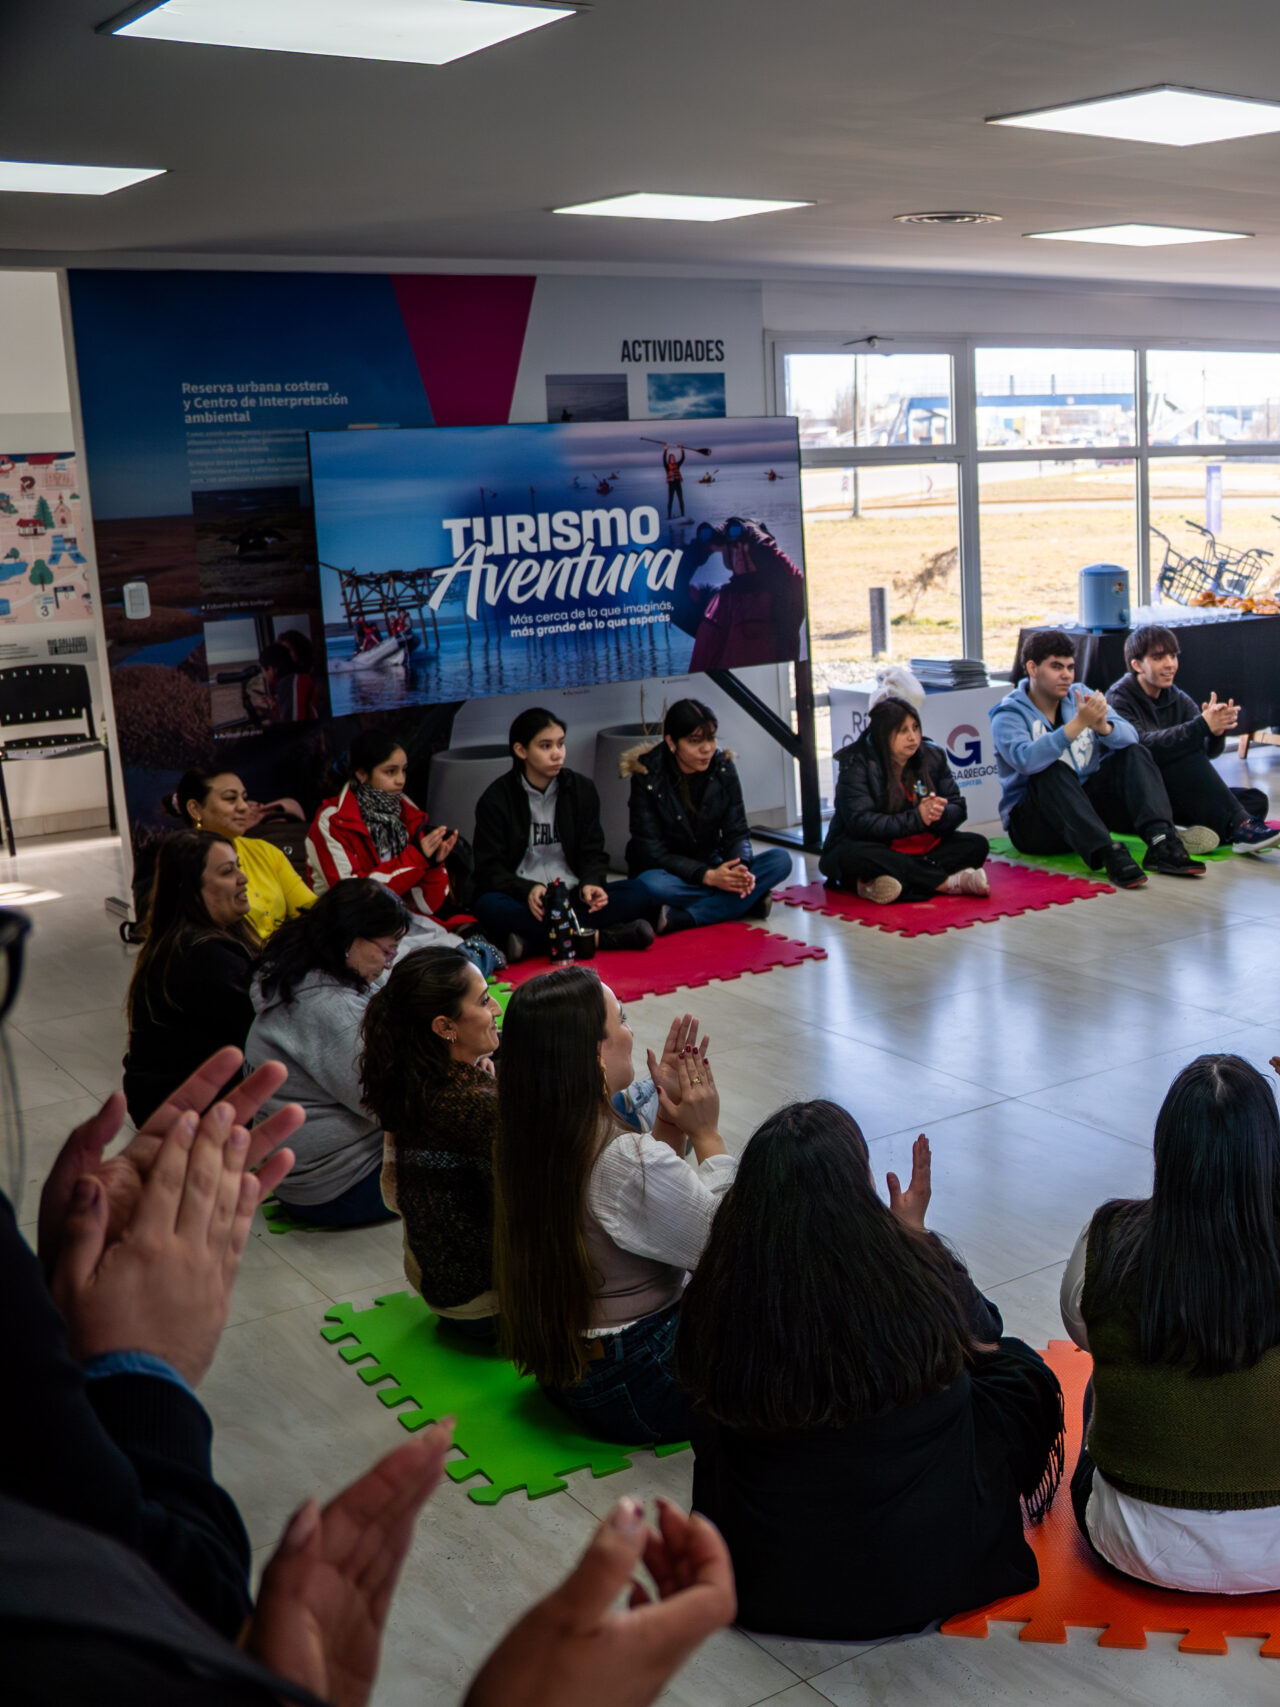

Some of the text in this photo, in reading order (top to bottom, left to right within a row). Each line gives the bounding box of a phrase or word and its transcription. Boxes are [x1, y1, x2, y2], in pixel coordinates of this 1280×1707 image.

[620, 339, 725, 362] ACTIVIDADES
[181, 380, 329, 394] Reserva urbana costera
[183, 392, 349, 411] y Centro de Interpretación
[184, 411, 251, 424] ambiental
[442, 505, 661, 559] TURISMO
[428, 538, 684, 621] Aventura
[509, 614, 534, 625] Más
[535, 612, 569, 624] cerca
[570, 609, 586, 620] de
[587, 607, 598, 618] lo
[599, 607, 621, 620] que
[510, 613, 671, 638] más grande de lo que esperás
[852, 711, 870, 734] Rí
